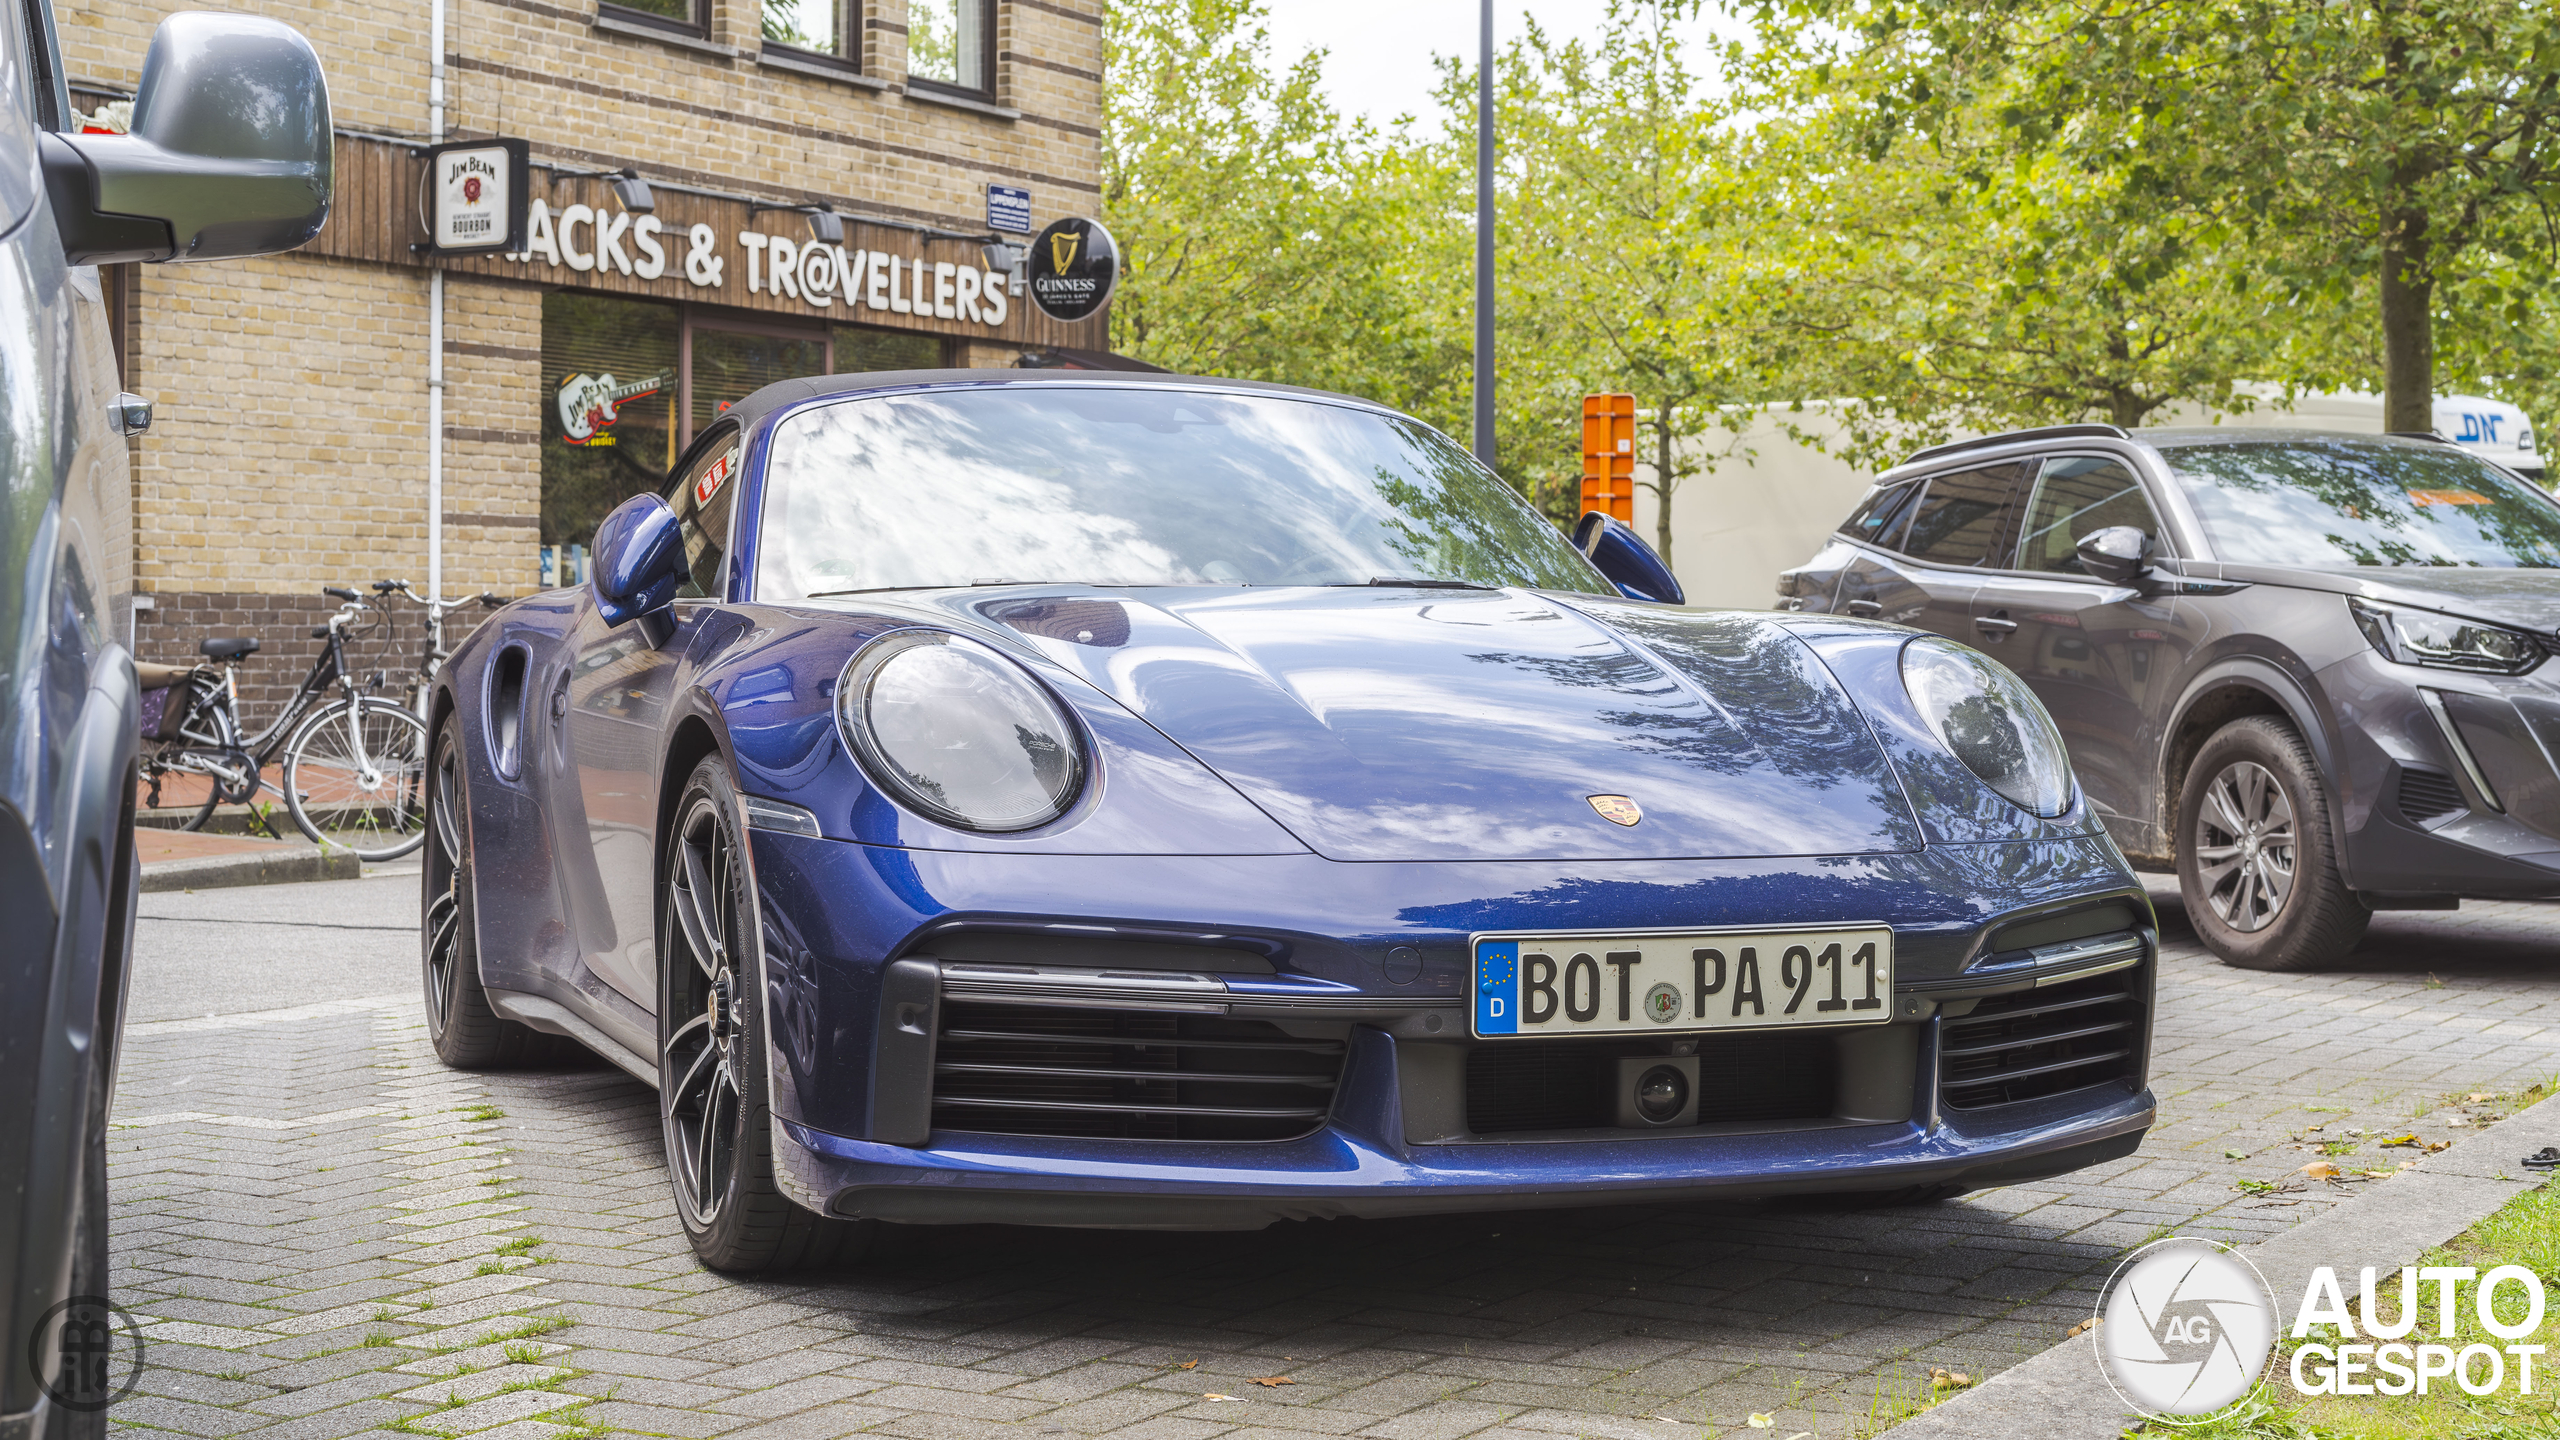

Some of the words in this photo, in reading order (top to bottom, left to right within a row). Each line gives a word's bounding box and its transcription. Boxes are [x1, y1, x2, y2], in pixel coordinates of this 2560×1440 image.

[449, 162, 467, 185] JIM
[469, 156, 496, 181] BEAM
[453, 219, 491, 234] BOURBON
[486, 198, 666, 280] ACKS
[685, 223, 724, 287] &
[739, 230, 1007, 326] TR@VELLERS
[1036, 277, 1096, 293] GUINNESS
[1522, 951, 1642, 1025] BOT
[1692, 946, 1766, 1019] PA
[1781, 942, 1883, 1016] 911
[1490, 997, 1505, 1018] D
